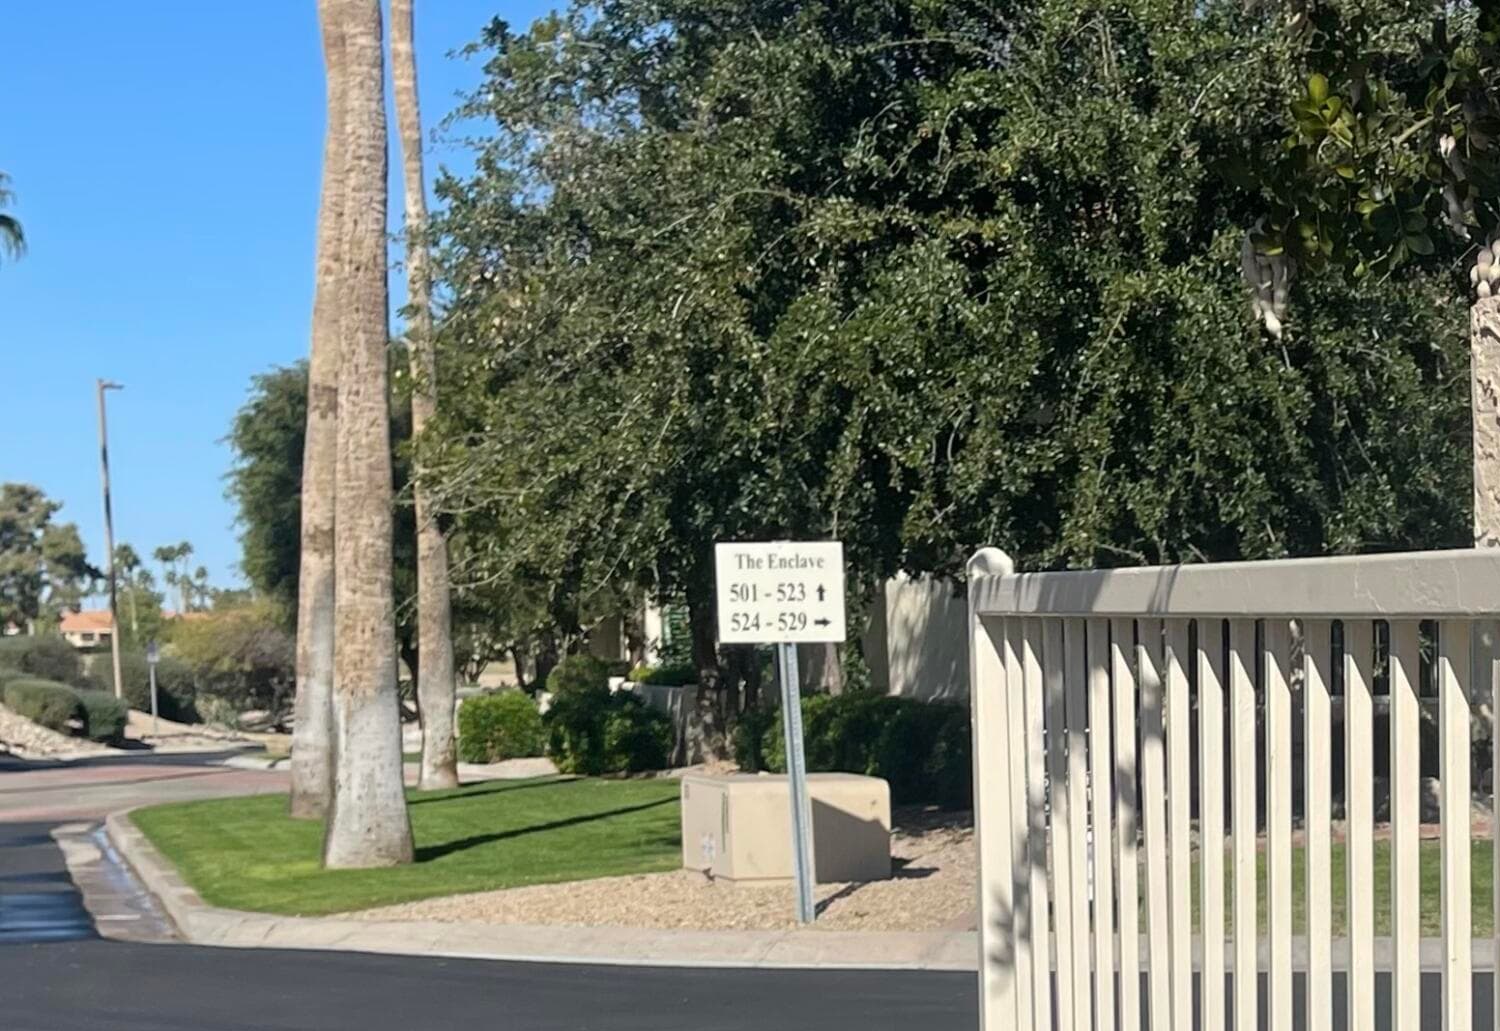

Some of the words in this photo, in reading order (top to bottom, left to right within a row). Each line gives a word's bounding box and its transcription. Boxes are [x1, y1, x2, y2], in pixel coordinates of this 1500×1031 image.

[735, 553, 763, 569] The
[768, 553, 824, 569] Enclave
[729, 583, 758, 602] 501
[776, 582, 806, 602] 523
[731, 612, 761, 632] 524
[778, 611, 807, 631] 529
